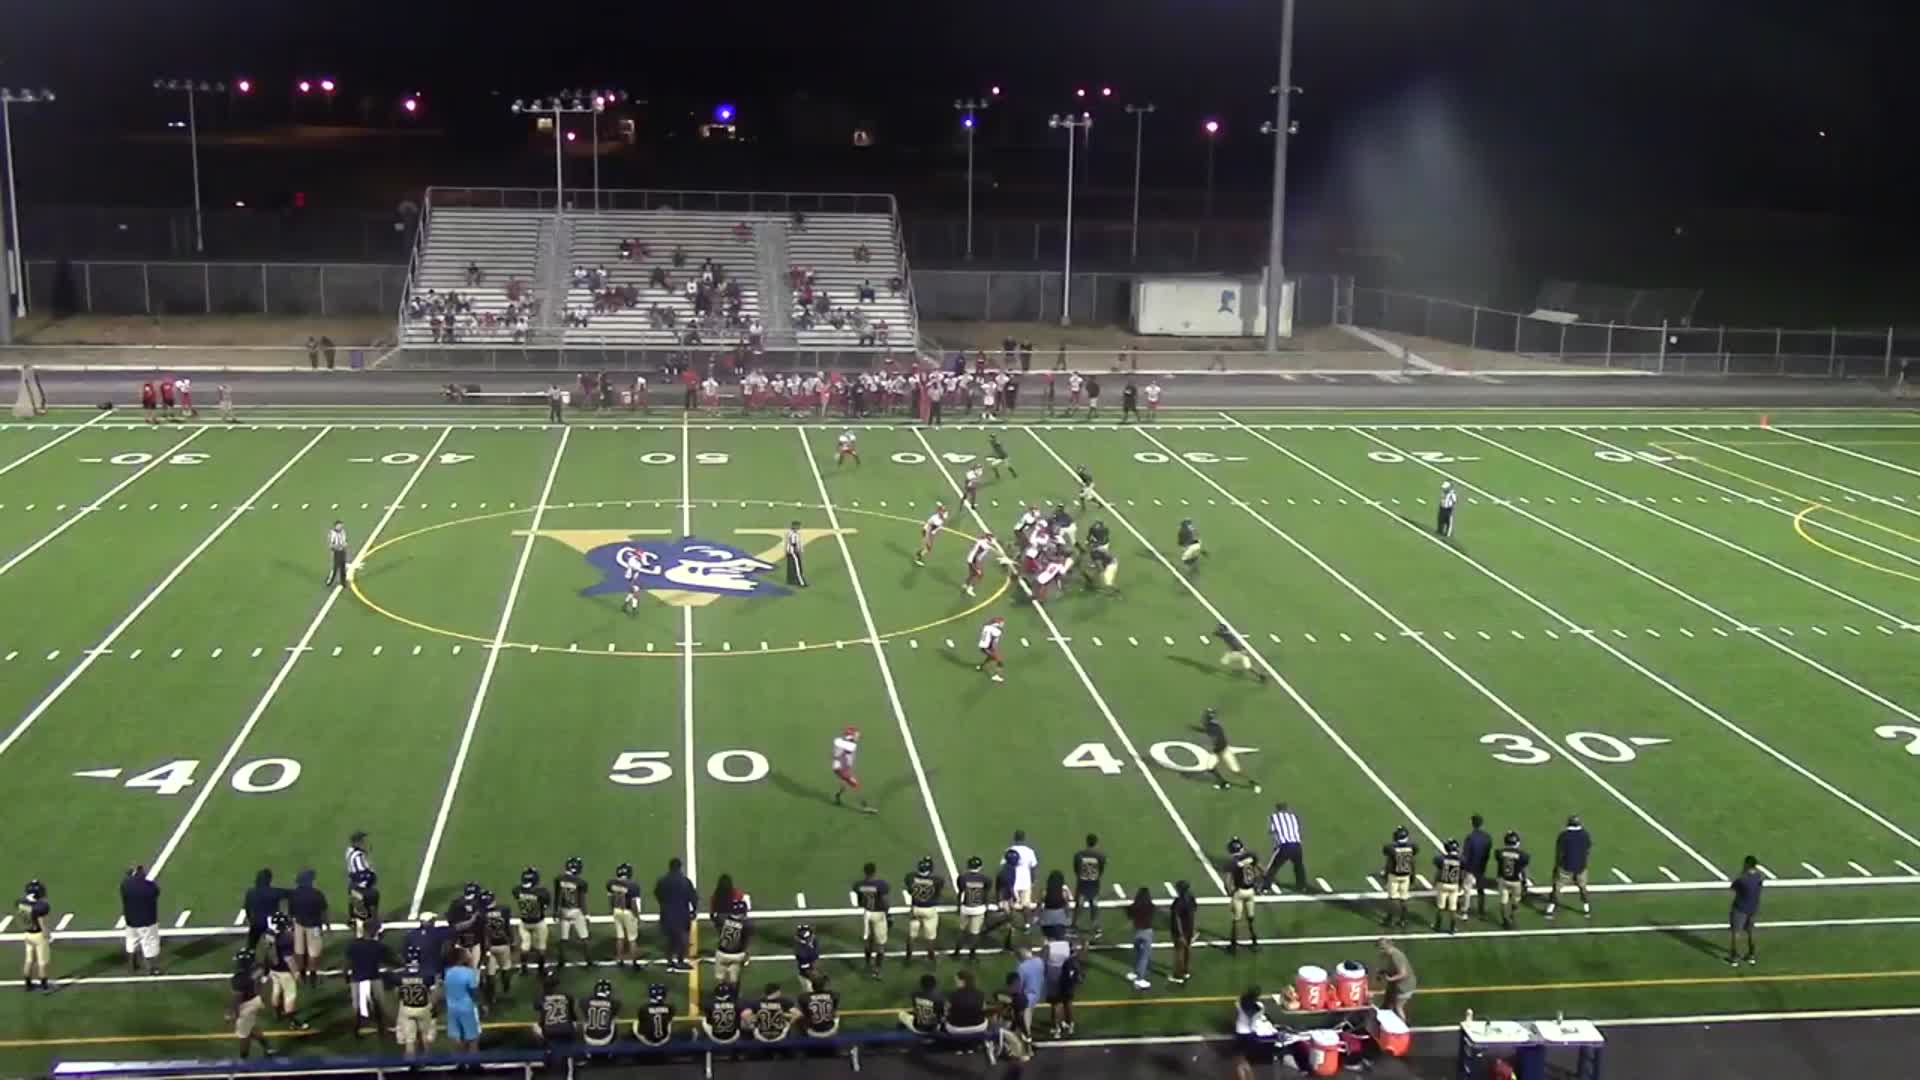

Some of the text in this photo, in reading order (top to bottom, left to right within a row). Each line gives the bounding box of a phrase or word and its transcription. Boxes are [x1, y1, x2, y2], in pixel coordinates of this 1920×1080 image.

[1062, 740, 1213, 774] 40
[1479, 731, 1637, 765] 30
[124, 757, 302, 795] 40
[608, 749, 770, 785] 50
[653, 1014, 664, 1038] 1
